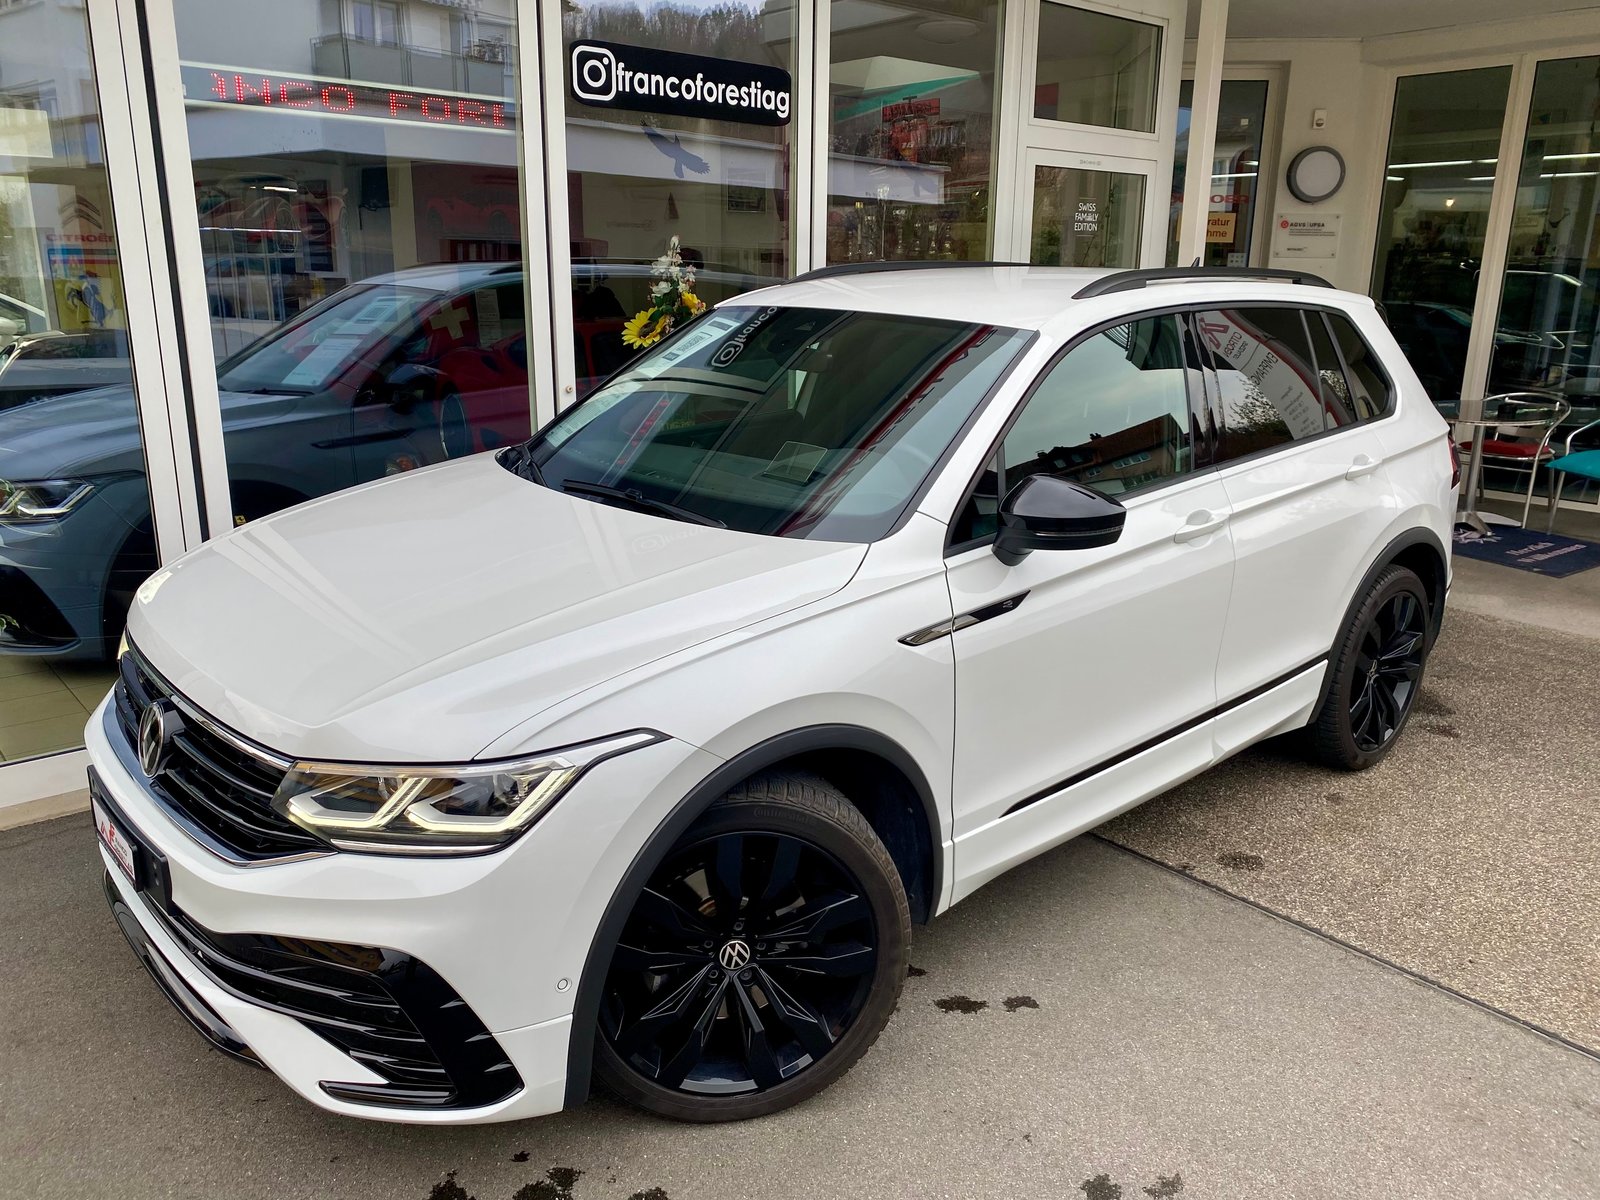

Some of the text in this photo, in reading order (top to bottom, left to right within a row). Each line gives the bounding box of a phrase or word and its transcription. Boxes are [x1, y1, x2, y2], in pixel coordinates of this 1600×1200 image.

[616, 62, 790, 118] francoforestiag
[1078, 202, 1096, 212] SWISS
[1074, 222, 1098, 232] EDITION
[1207, 218, 1231, 226] ratur
